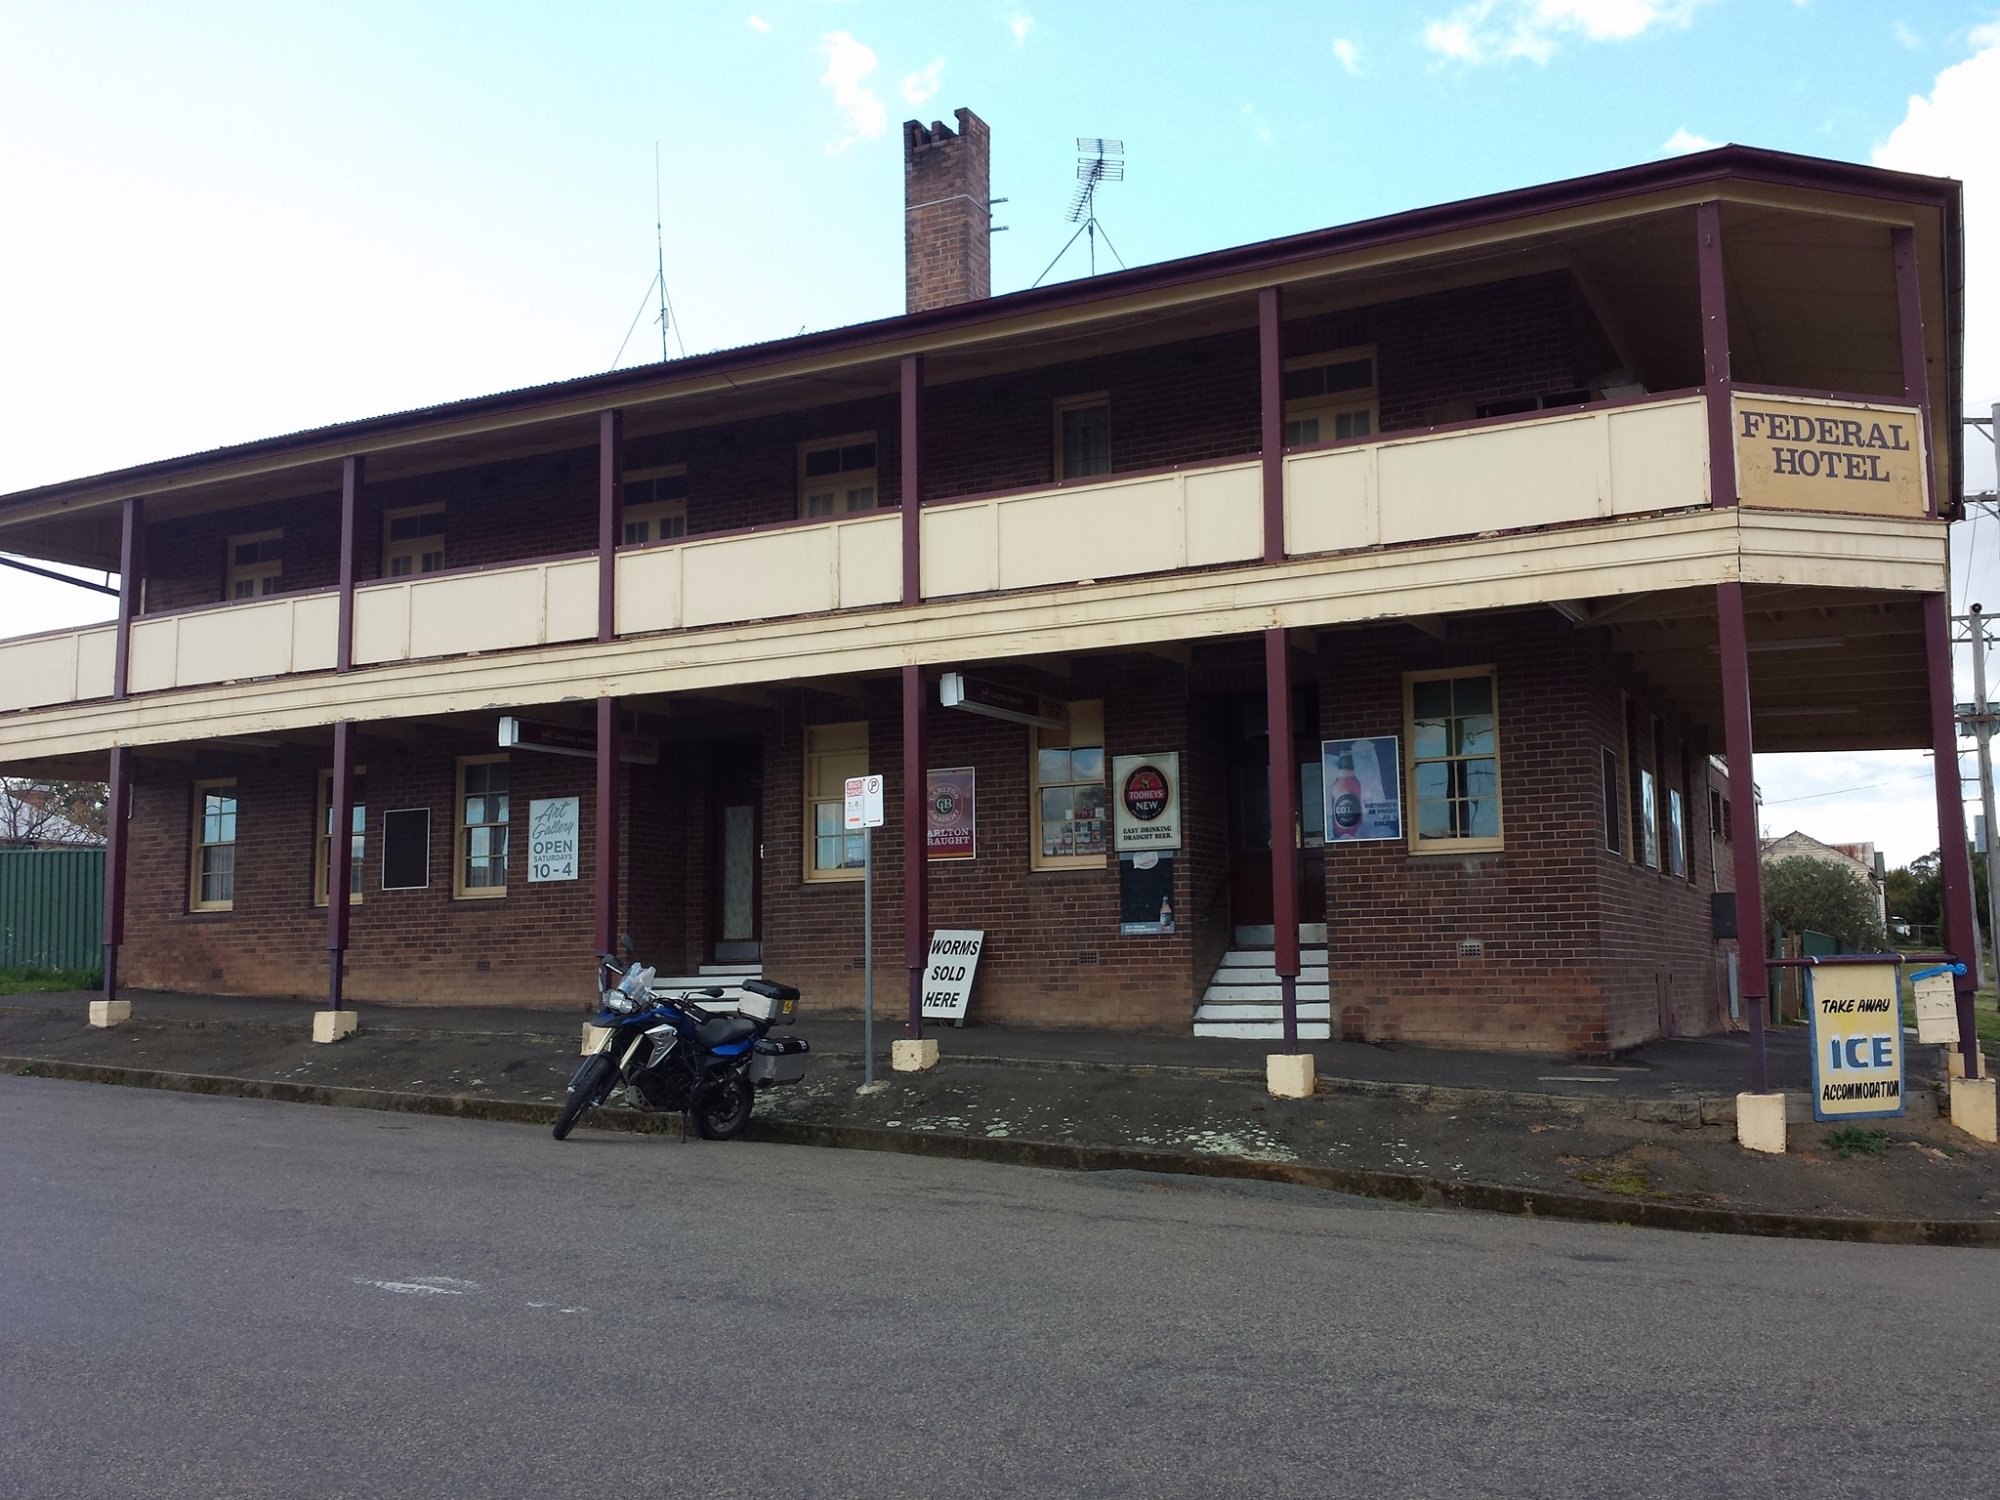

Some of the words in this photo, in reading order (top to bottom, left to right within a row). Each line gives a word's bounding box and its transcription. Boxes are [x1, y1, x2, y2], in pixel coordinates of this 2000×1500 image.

[1740, 410, 1910, 451] FEDERAL
[1772, 447, 1890, 482] HOTEL
[1129, 790, 1163, 800] TOOHEYS
[535, 801, 572, 823] Art
[1136, 801, 1158, 811] NEW
[532, 819, 575, 840] Gallery
[927, 827, 970, 838] ARLTON
[1140, 826, 1172, 834] DRINKING
[533, 840, 573, 855] OPEN
[927, 836, 970, 846] RAUGHT
[534, 853, 573, 863] SATURDAYS
[931, 940, 980, 956] WORMS
[931, 965, 966, 982] SOLD
[923, 991, 960, 1008] HERE
[1822, 999, 1855, 1014] TAKE
[1857, 998, 1891, 1013] AWAY
[1831, 1036, 1893, 1069] ICE
[1822, 1079, 1900, 1101] ACCOMMODATION
